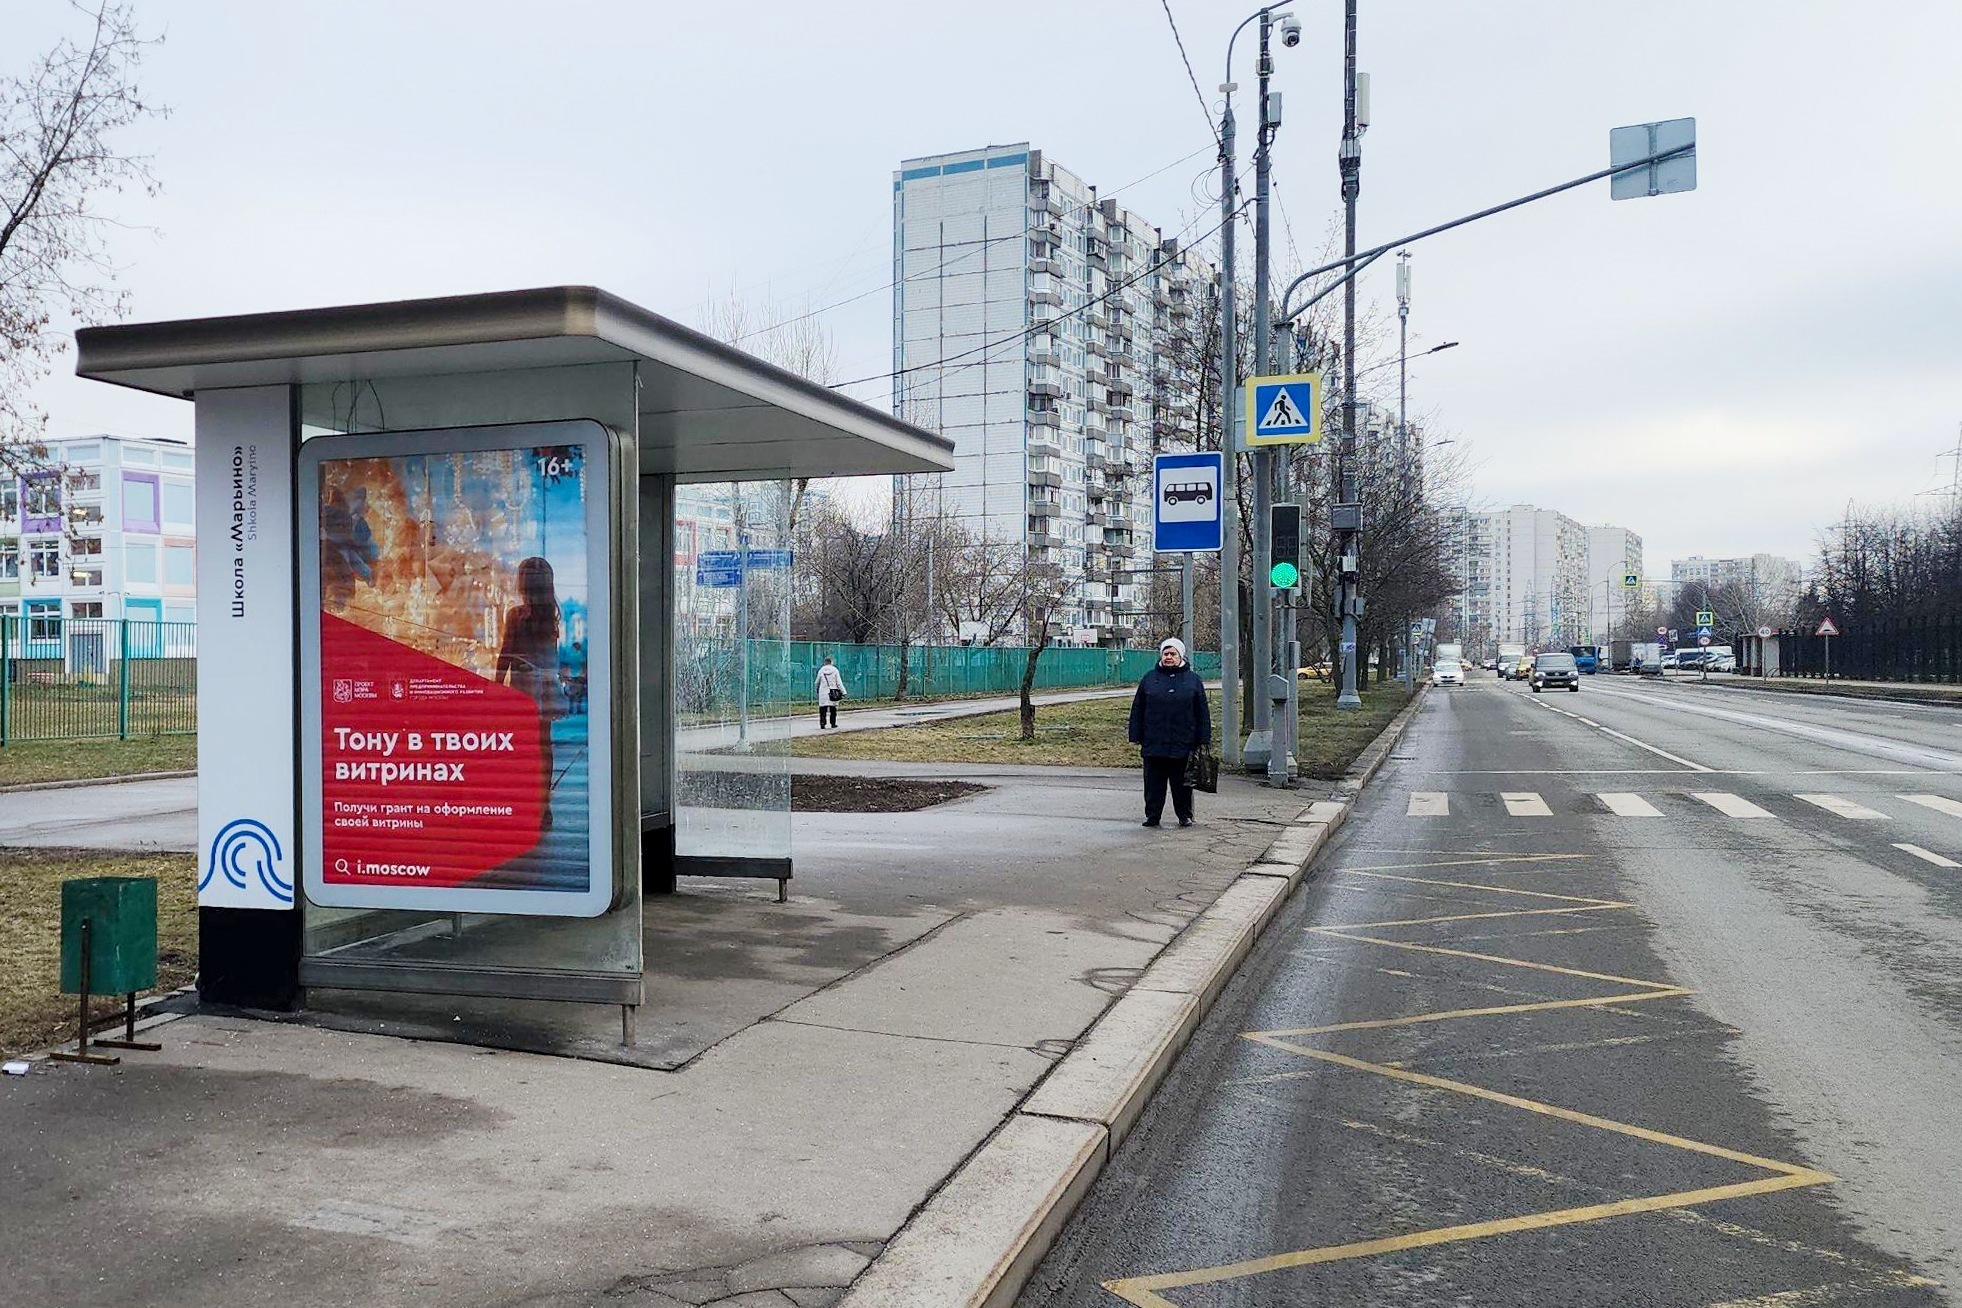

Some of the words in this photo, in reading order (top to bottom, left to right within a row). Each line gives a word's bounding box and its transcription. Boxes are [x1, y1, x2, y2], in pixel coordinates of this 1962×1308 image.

[247, 444, 258, 497] Maryino
[537, 456, 574, 477] 16+
[230, 445, 246, 552] «Марьино»
[248, 500, 257, 541] Shkola
[232, 557, 245, 618] Школа
[334, 727, 399, 757] Тону
[407, 732, 424, 751] в
[430, 732, 515, 752] твоих
[335, 762, 465, 786] витринах
[334, 801, 378, 816] Получи
[380, 804, 413, 816] грант
[416, 806, 431, 814] на
[433, 802, 513, 817] оформление
[334, 815, 370, 828] своей
[372, 817, 424, 830] витрины
[356, 859, 431, 877] i.moscow
